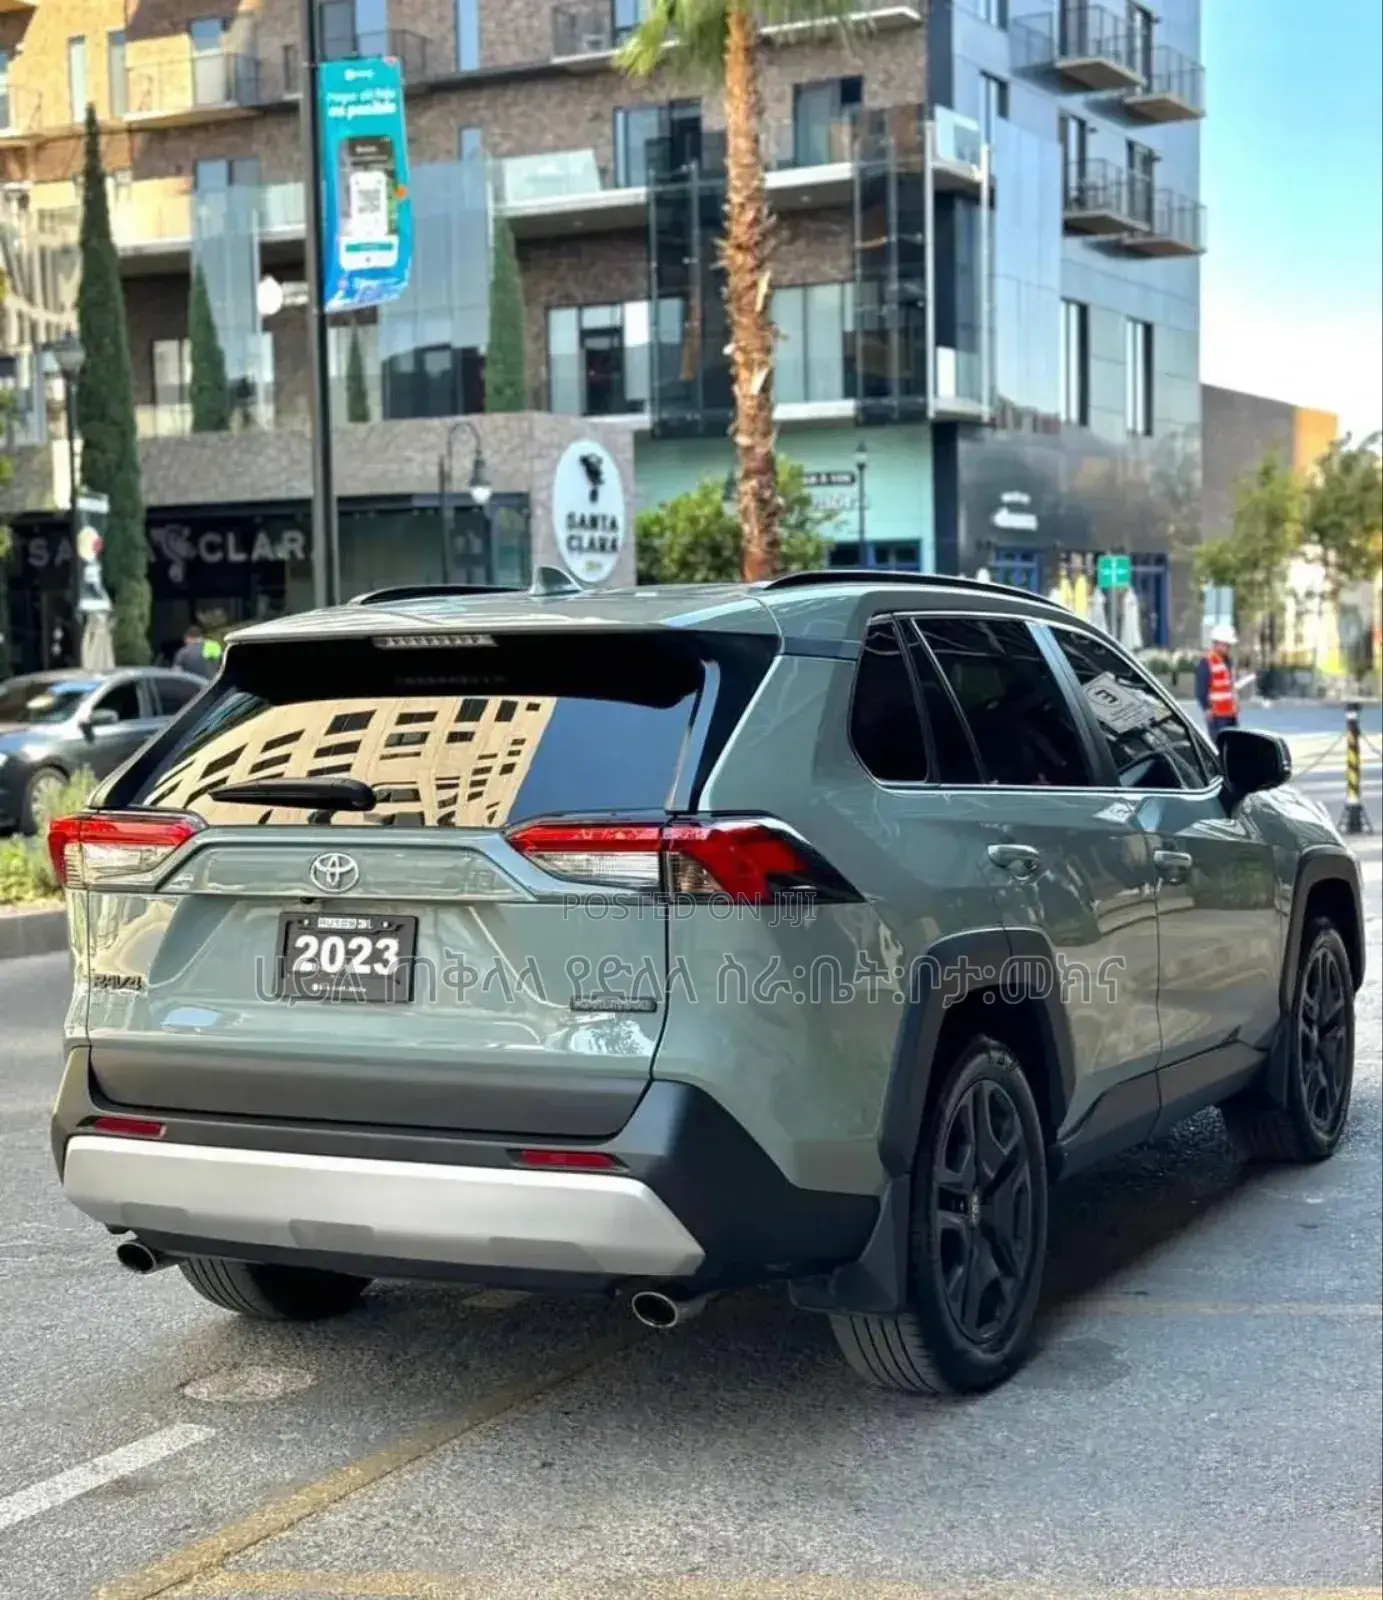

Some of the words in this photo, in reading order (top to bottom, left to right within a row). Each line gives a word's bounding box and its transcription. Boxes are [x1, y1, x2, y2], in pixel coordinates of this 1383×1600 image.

[566, 511, 619, 532] SANTA
[198, 529, 314, 564] CLAR
[566, 534, 620, 554] CLARA
[292, 934, 400, 976] 2023
